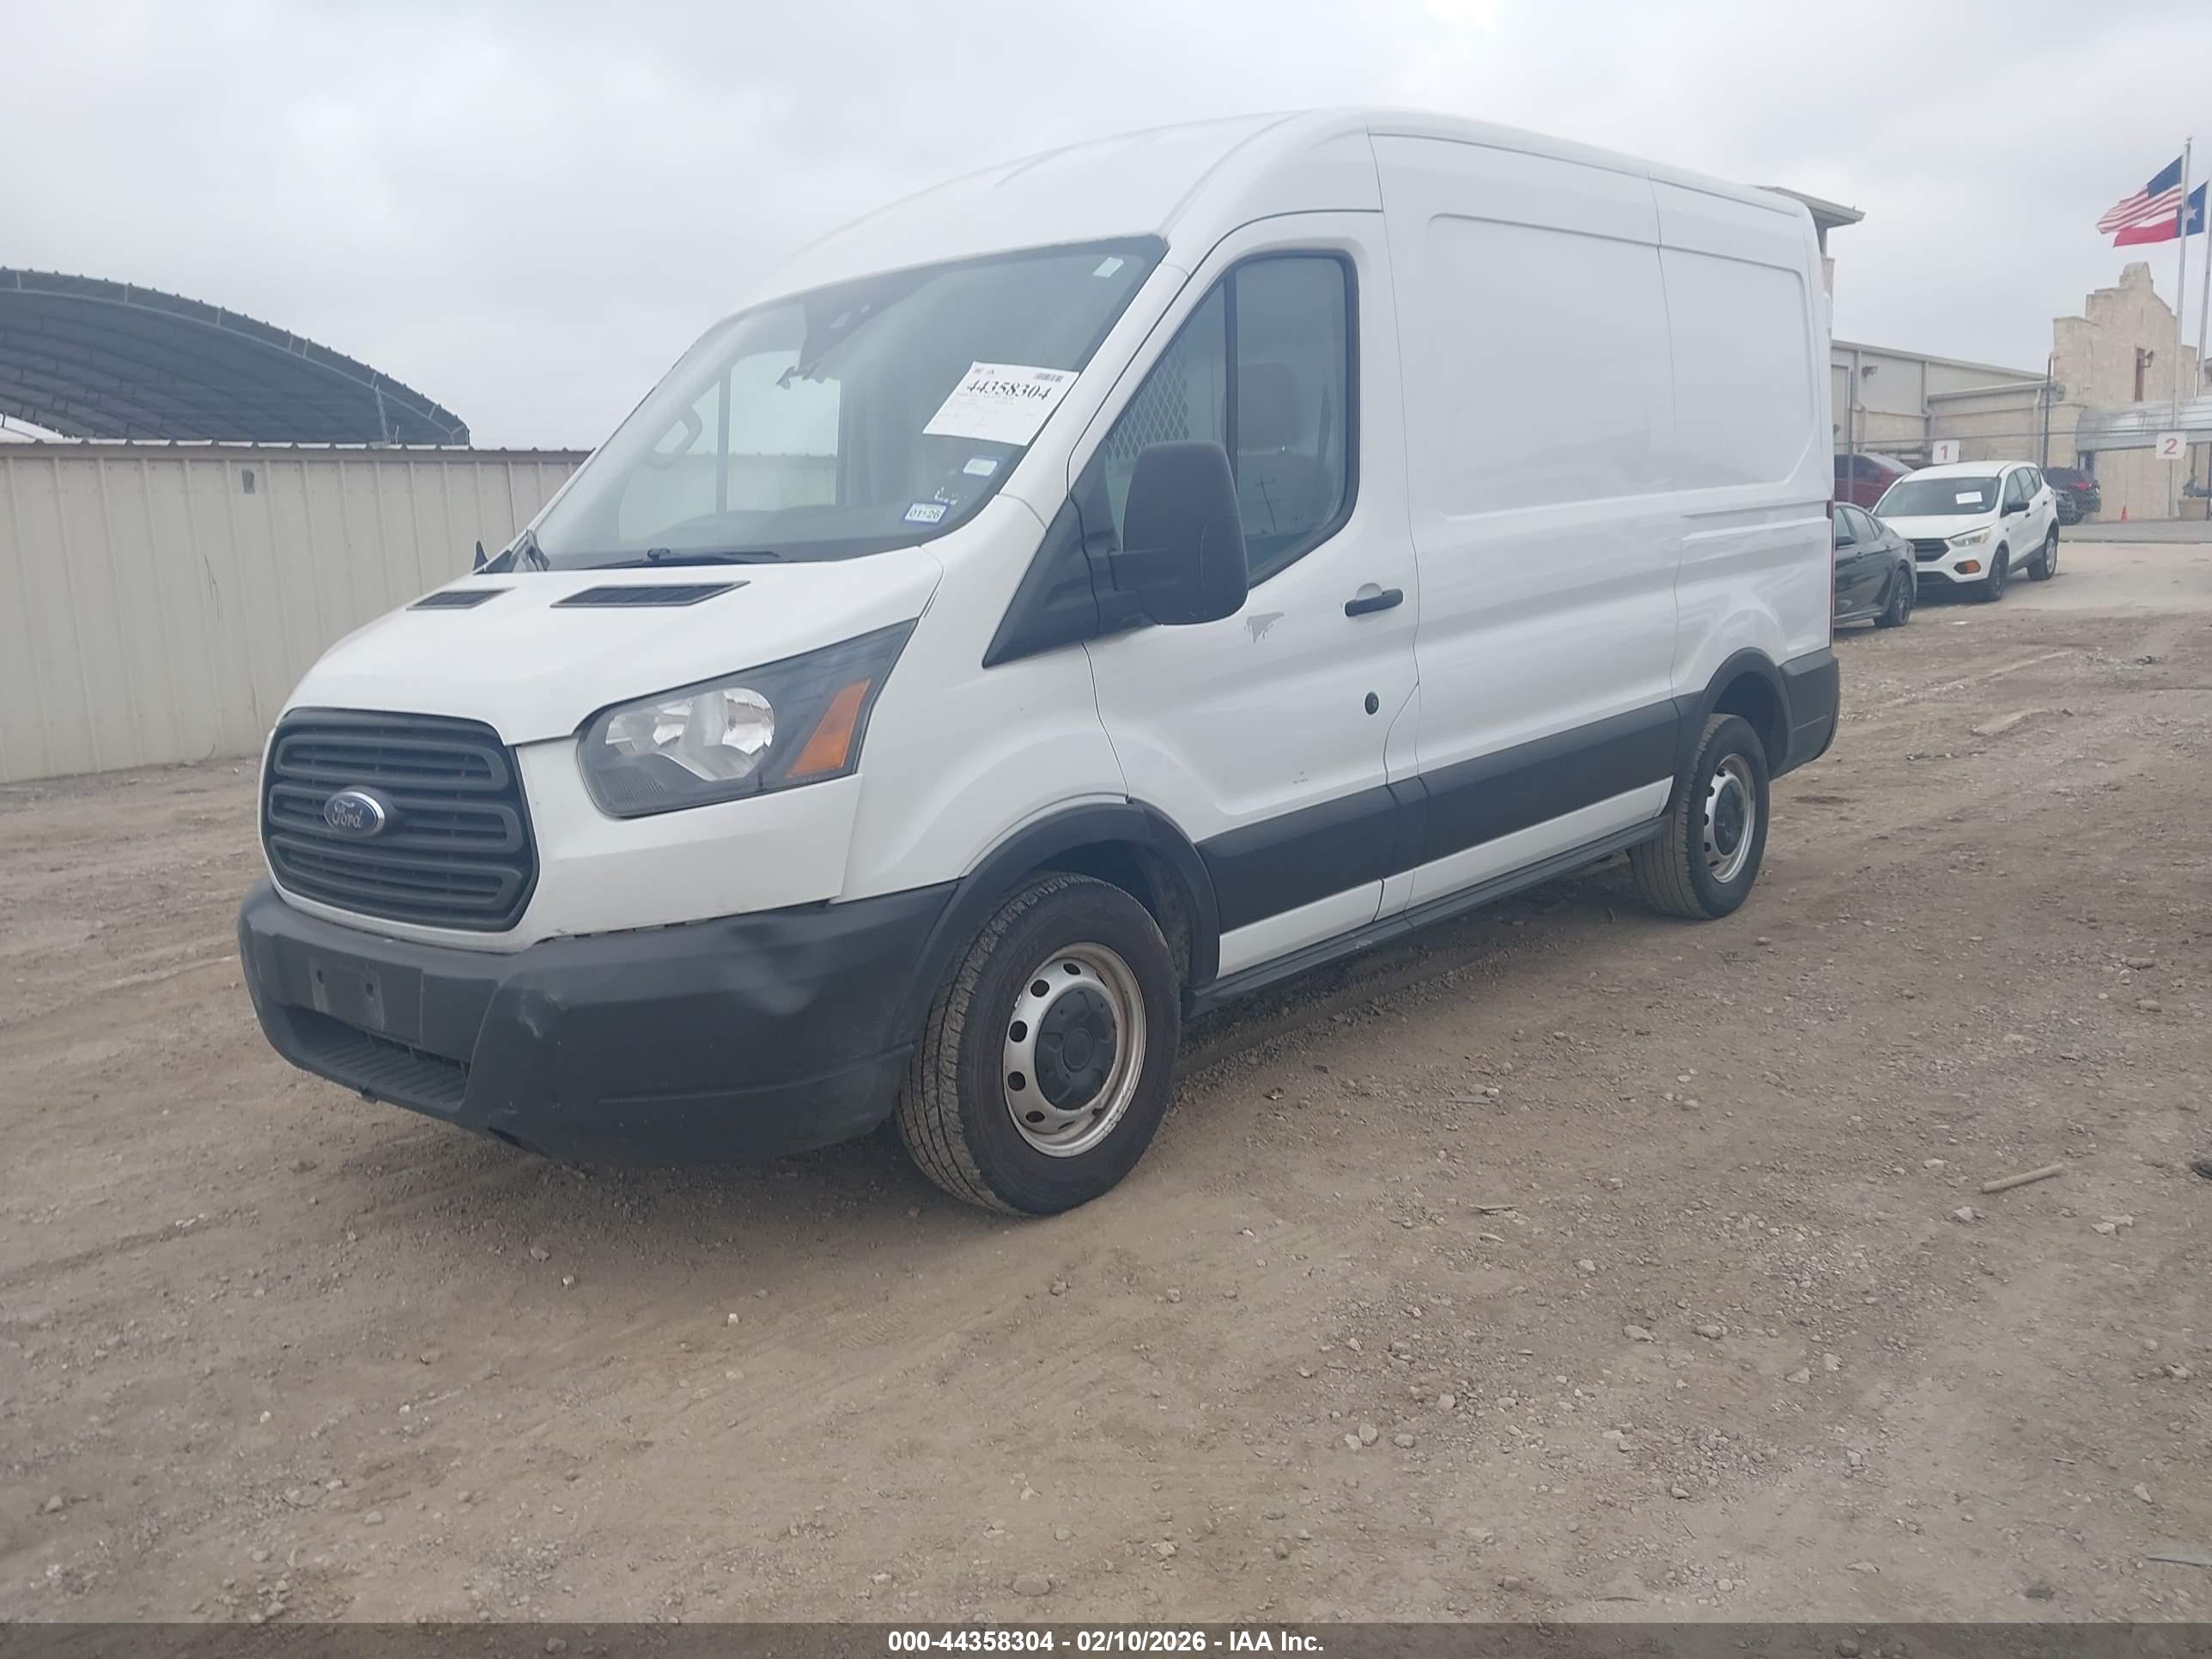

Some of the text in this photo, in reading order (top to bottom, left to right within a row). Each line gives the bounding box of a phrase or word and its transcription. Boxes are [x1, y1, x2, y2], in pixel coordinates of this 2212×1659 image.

[967, 380, 1052, 400] 44358304
[1940, 445, 1948, 461] 1
[2164, 438, 2178, 454] 2
[331, 799, 362, 829] Ford
